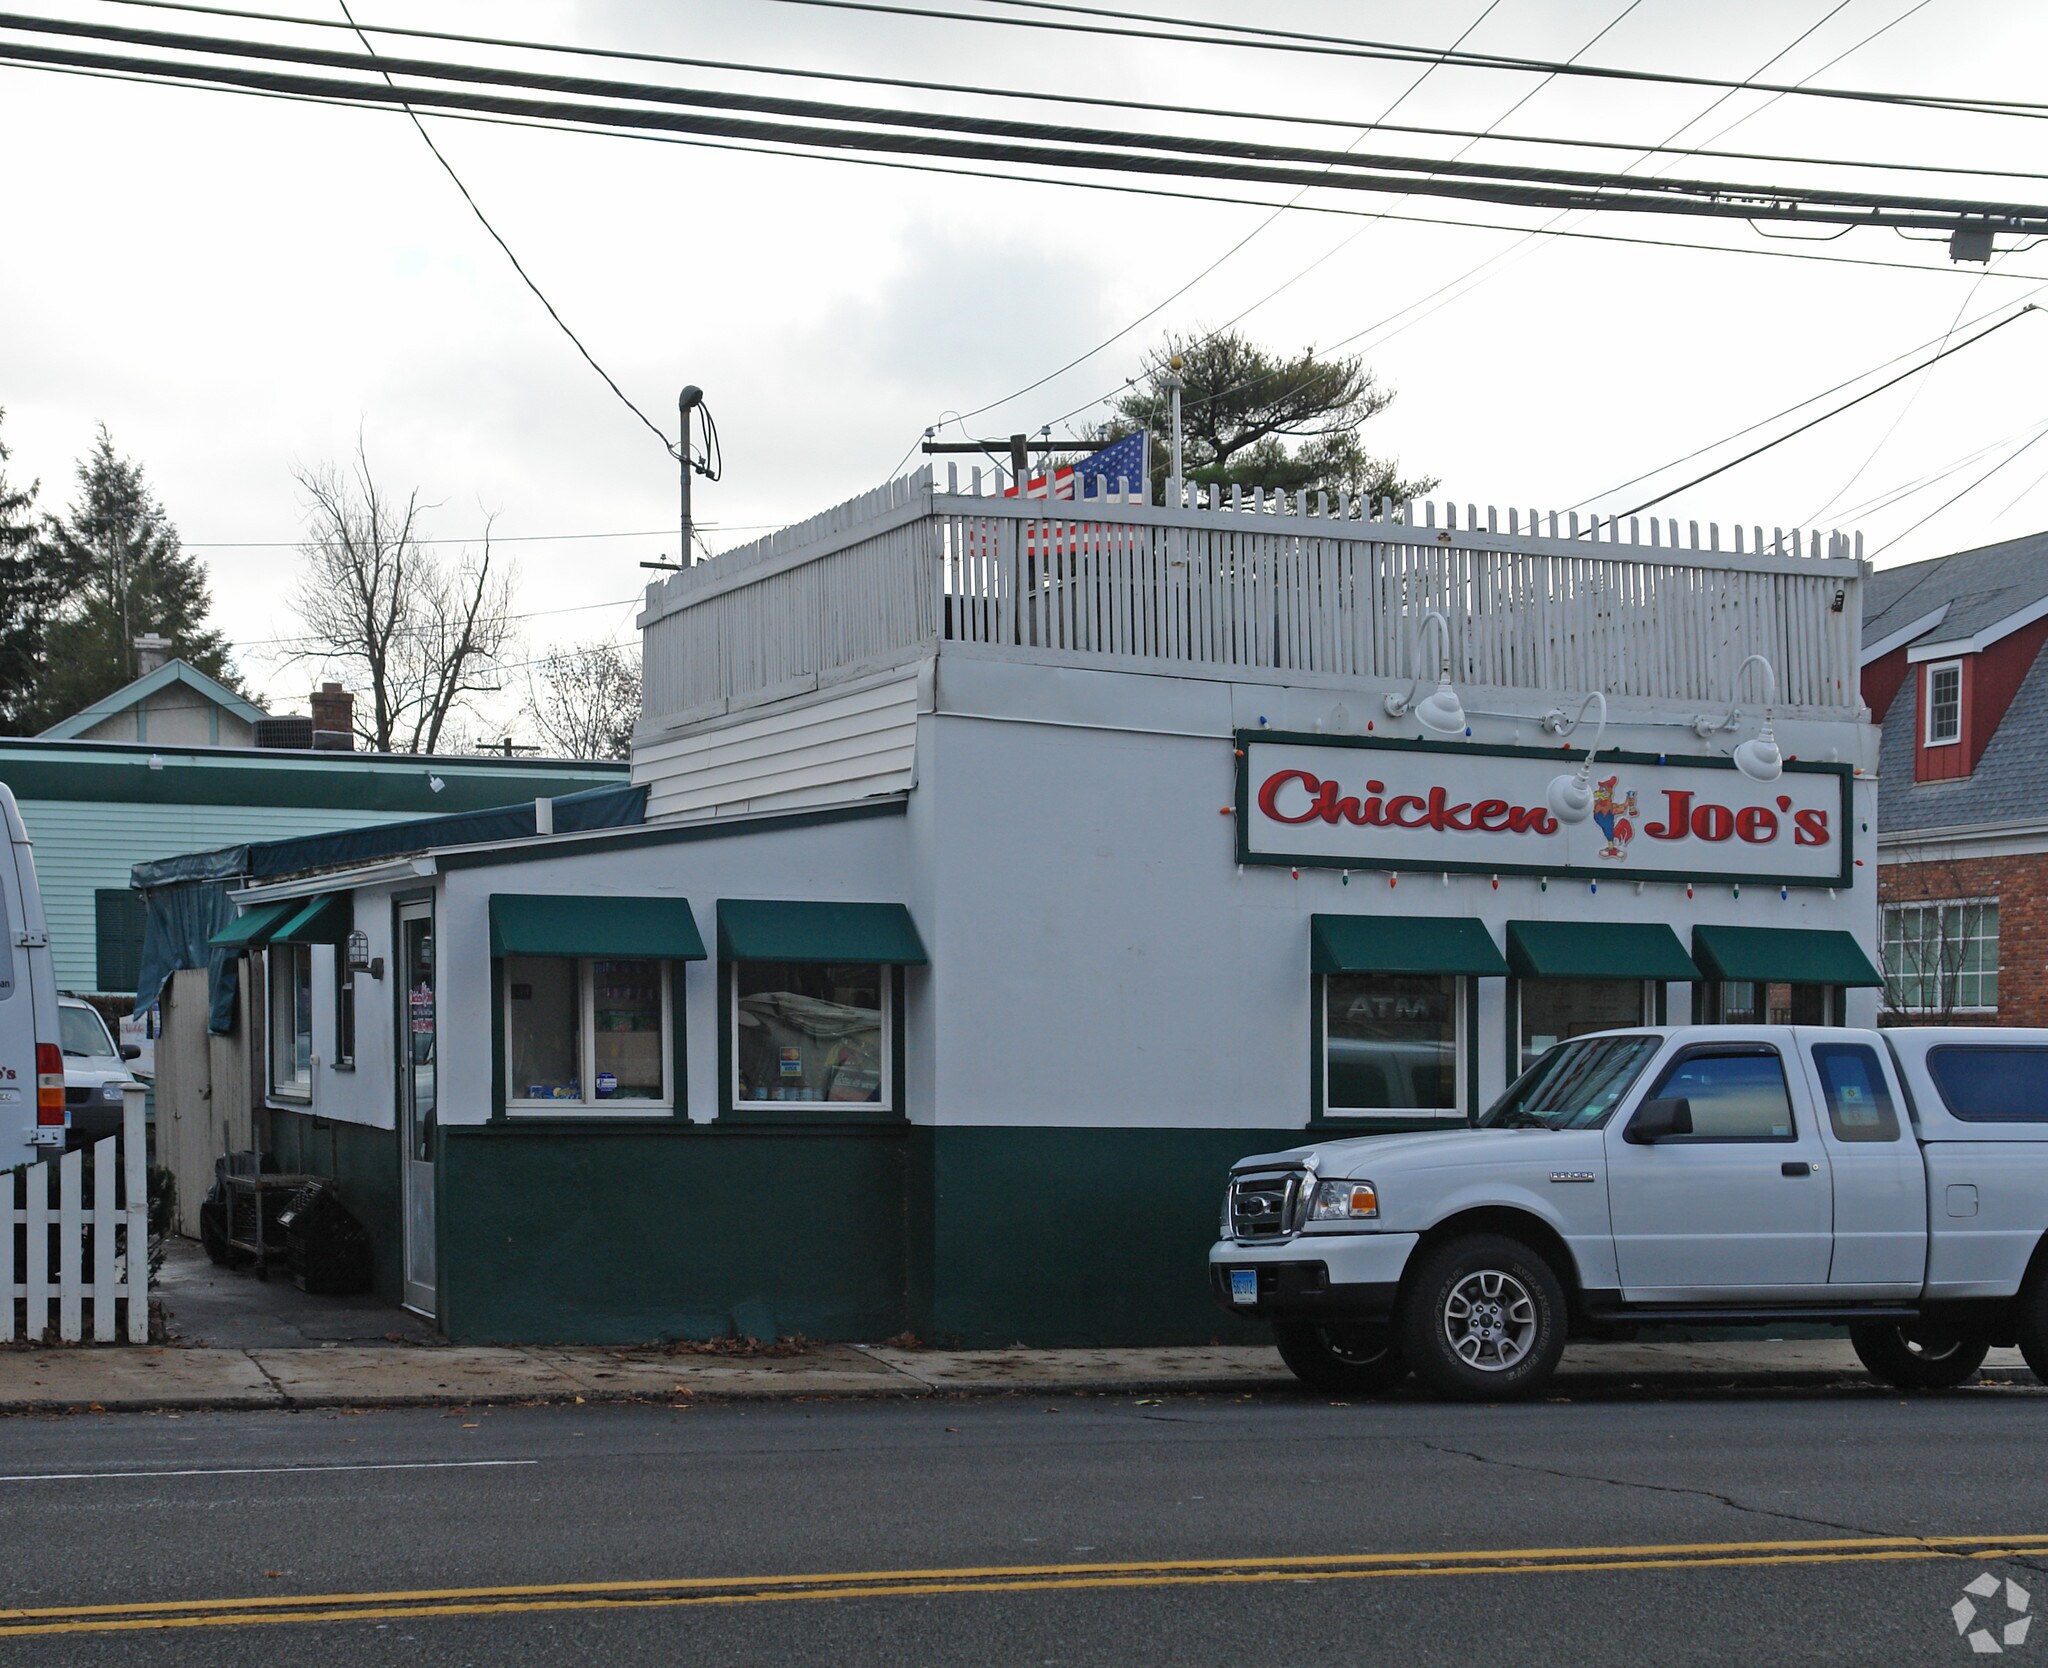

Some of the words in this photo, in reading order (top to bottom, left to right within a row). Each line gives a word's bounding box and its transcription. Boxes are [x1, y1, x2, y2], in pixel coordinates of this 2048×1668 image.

[1258, 769, 1558, 835] Chicken
[1644, 789, 1830, 846] Joe's
[1347, 997, 1429, 1018] ATM
[1551, 1171, 1596, 1180] RANGER
